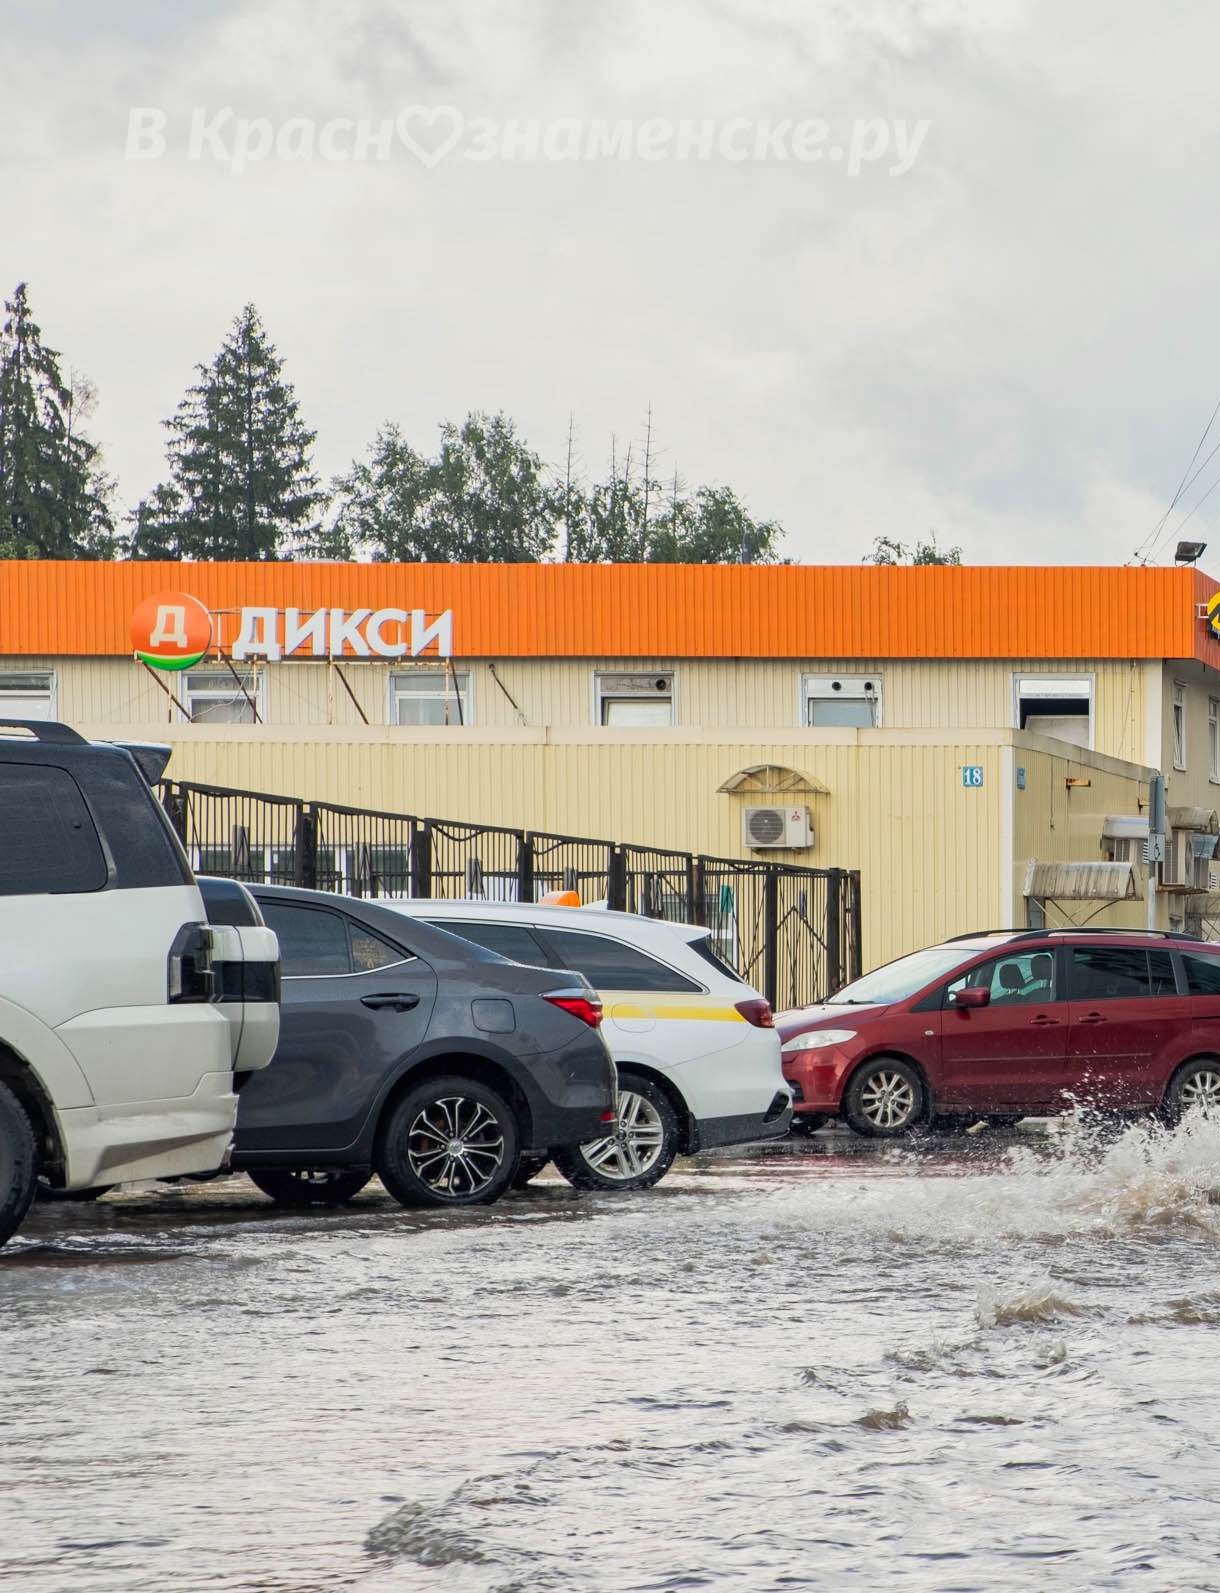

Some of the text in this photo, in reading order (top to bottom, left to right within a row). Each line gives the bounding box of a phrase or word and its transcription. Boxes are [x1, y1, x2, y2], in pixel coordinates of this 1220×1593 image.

[150, 605, 453, 661] Д ДИКСИ
[964, 768, 981, 785] 18
